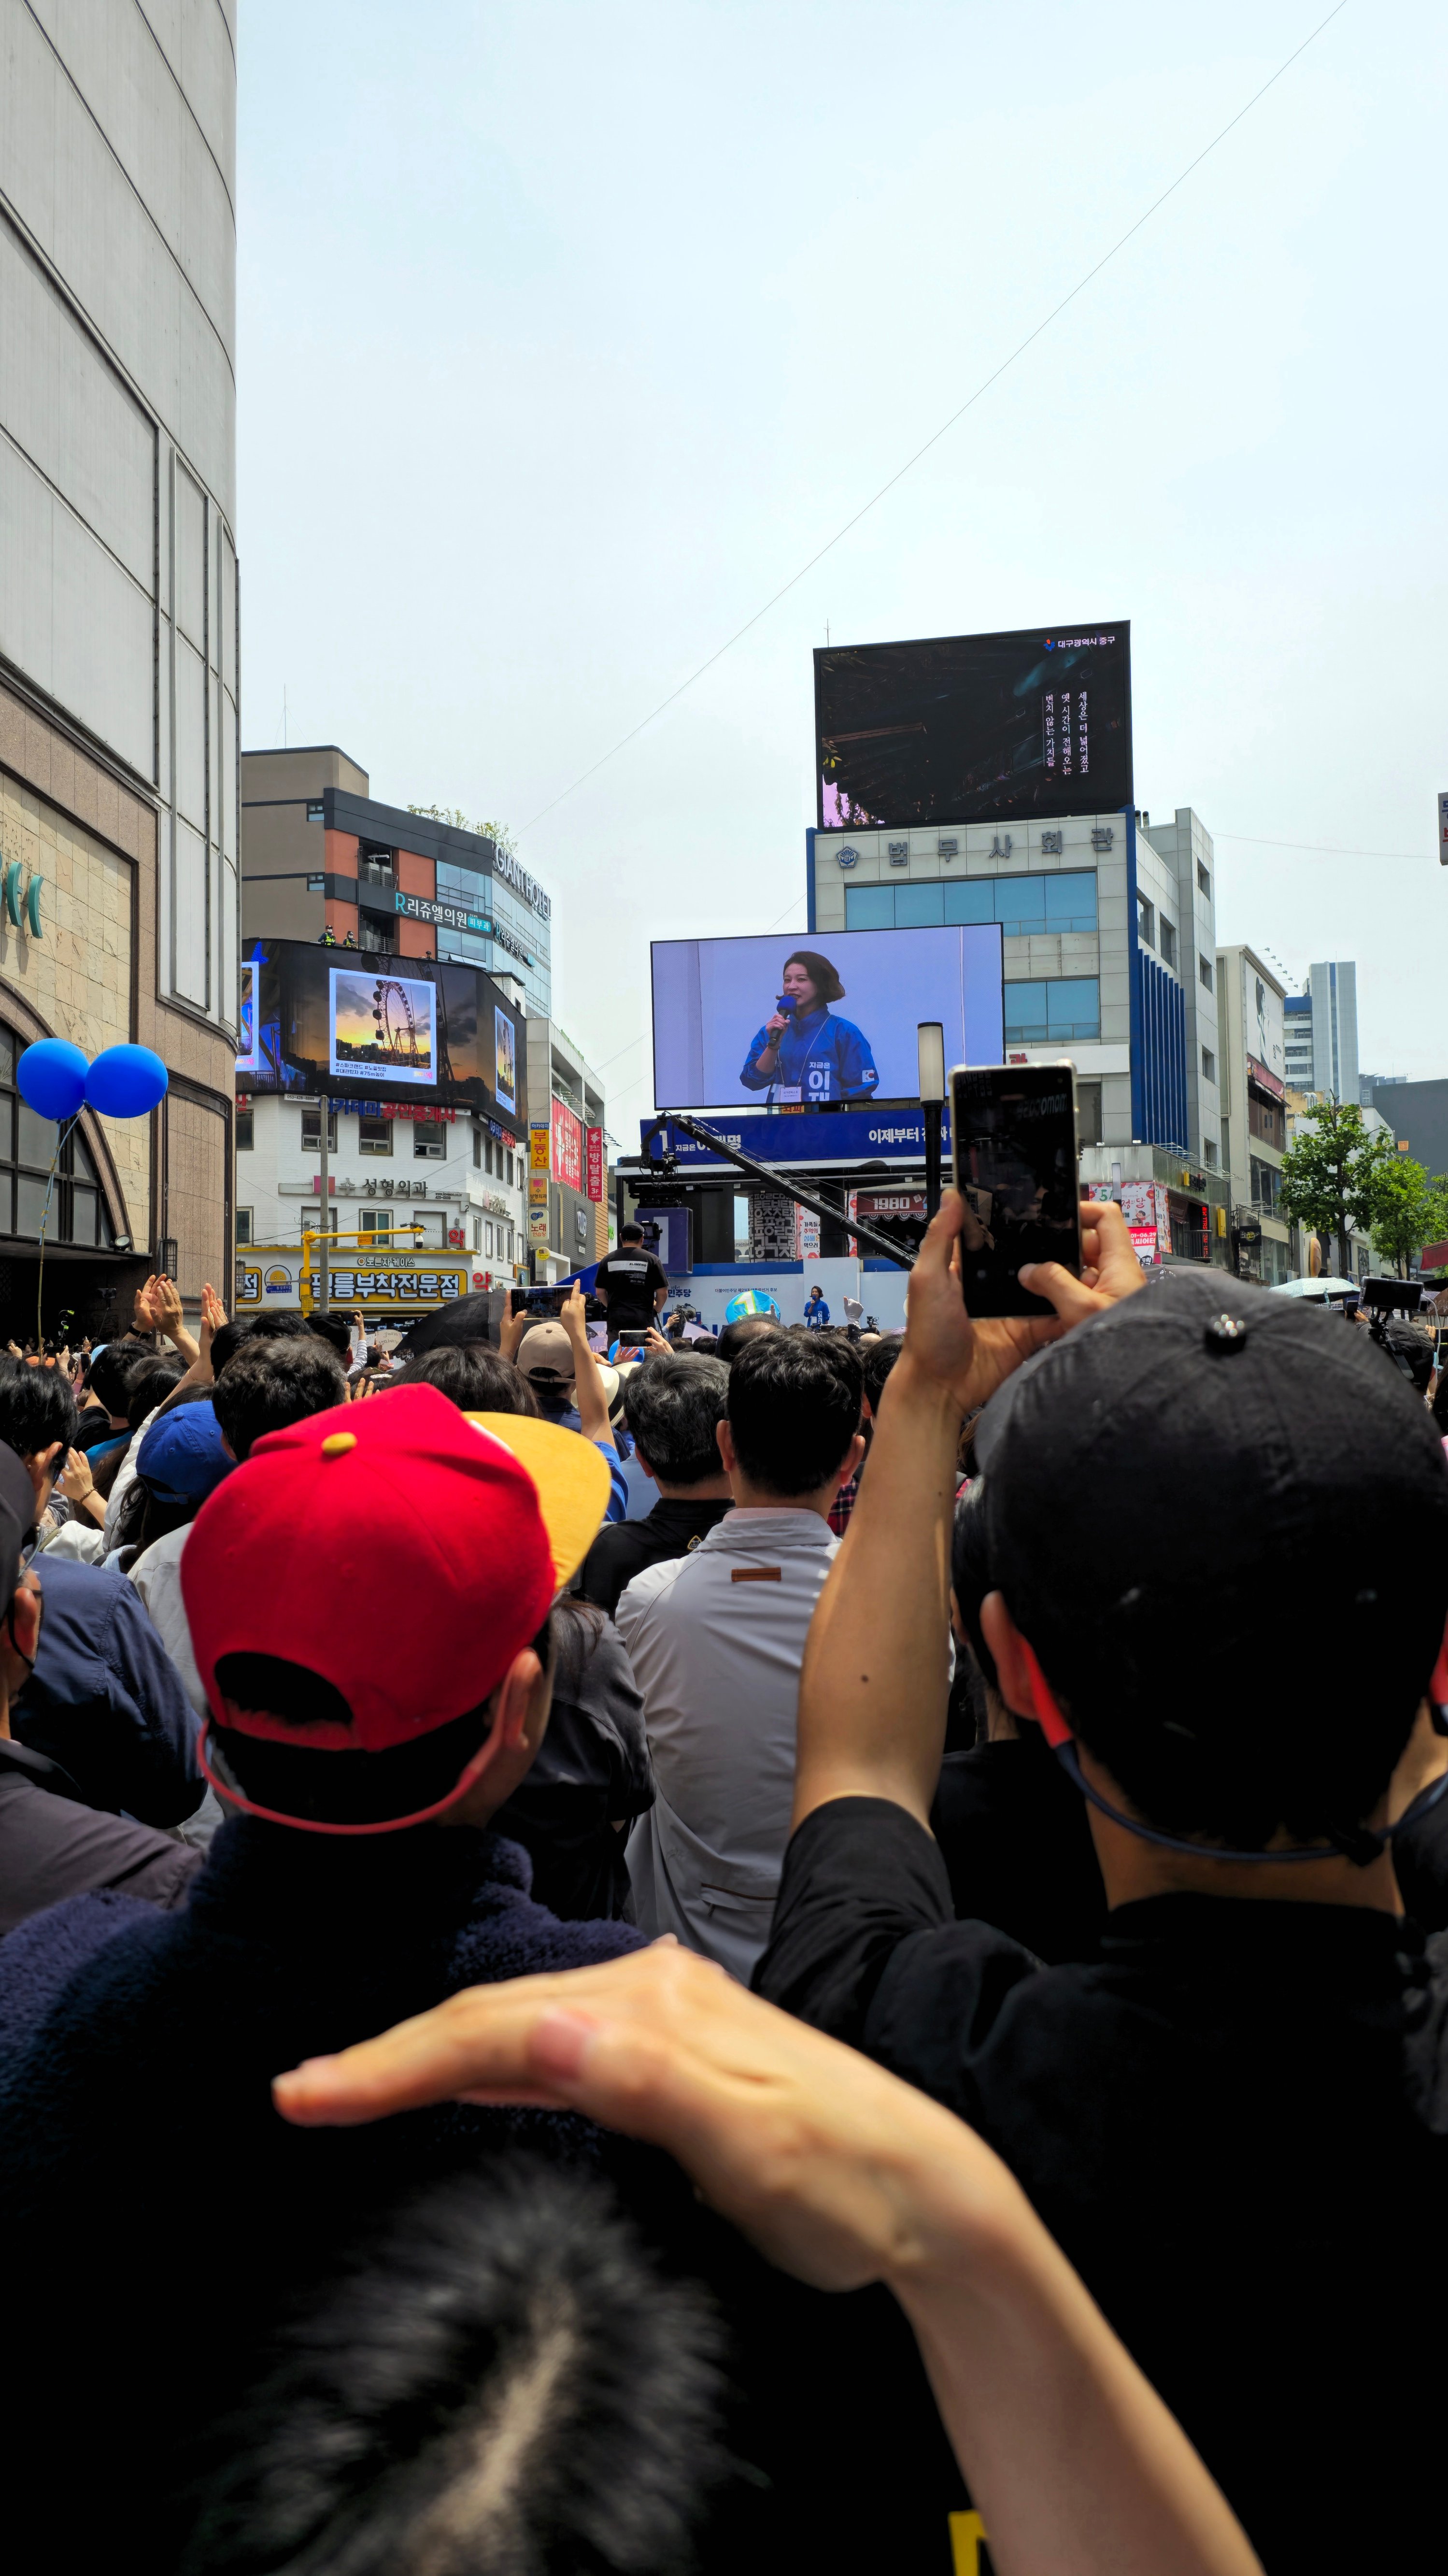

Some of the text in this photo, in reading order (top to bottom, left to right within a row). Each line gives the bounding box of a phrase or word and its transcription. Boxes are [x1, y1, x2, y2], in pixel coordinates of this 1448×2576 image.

[1058, 636, 1115, 648] 대구광역시 중구
[1046, 694, 1055, 767] 변치 않는 가치들
[1062, 693, 1072, 774] 옛 시간이 전해오는
[1078, 692, 1089, 773] 세상은 더 넓어졌고
[888, 828, 1114, 867] 법무사회관
[495, 844, 526, 893] GIANT
[396, 892, 467, 929] R 리쥬엘의원
[469, 918, 489, 931] 피부과
[501, 929, 524, 959] 리쥬엘의원
[382, 1102, 457, 1124] 공인중개사
[869, 1127, 919, 1144] 이제부터
[534, 1131, 547, 1167] 부동산
[589, 1153, 600, 1186] 방탈출
[340, 1177, 429, 1199] 수 성형외과
[873, 1197, 910, 1210] 1980
[1136, 1197, 1146, 1208] 달
[448, 1229, 465, 1247] 약
[531, 1223, 546, 1231] 노래
[366, 1257, 415, 1267] 노른자 케이스
[311, 1272, 460, 1300] 필름부착전문점
[472, 1271, 492, 1290] 약
[667, 1288, 692, 1298] 민주당
